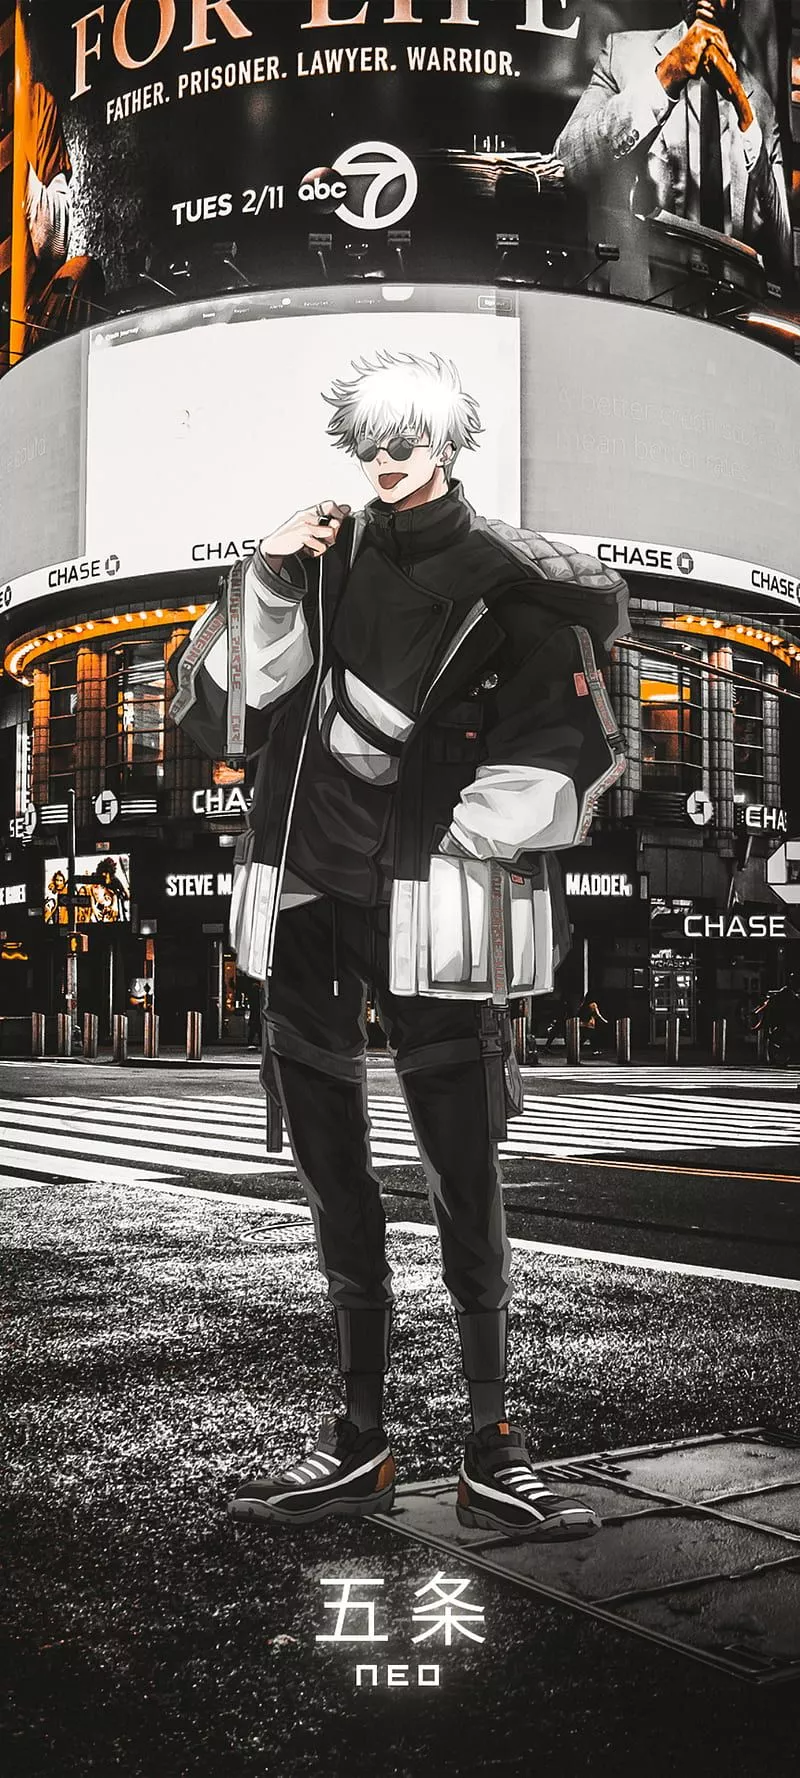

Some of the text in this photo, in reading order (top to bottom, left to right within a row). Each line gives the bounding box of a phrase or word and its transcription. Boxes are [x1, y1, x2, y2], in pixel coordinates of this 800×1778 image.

[106, 46, 521, 125] FATHER. PRISONER. LAWYER. WARRIOR.
[298, 178, 348, 201] abc
[171, 185, 284, 226] TUES 2/11
[191, 539, 264, 562] CHAS
[597, 543, 673, 570] CHASE
[48, 560, 101, 588] CHASE
[751, 569, 795, 599] CHASE
[192, 786, 255, 815] CHA
[166, 874, 213, 897] STEVE
[683, 915, 787, 938] CHASE
